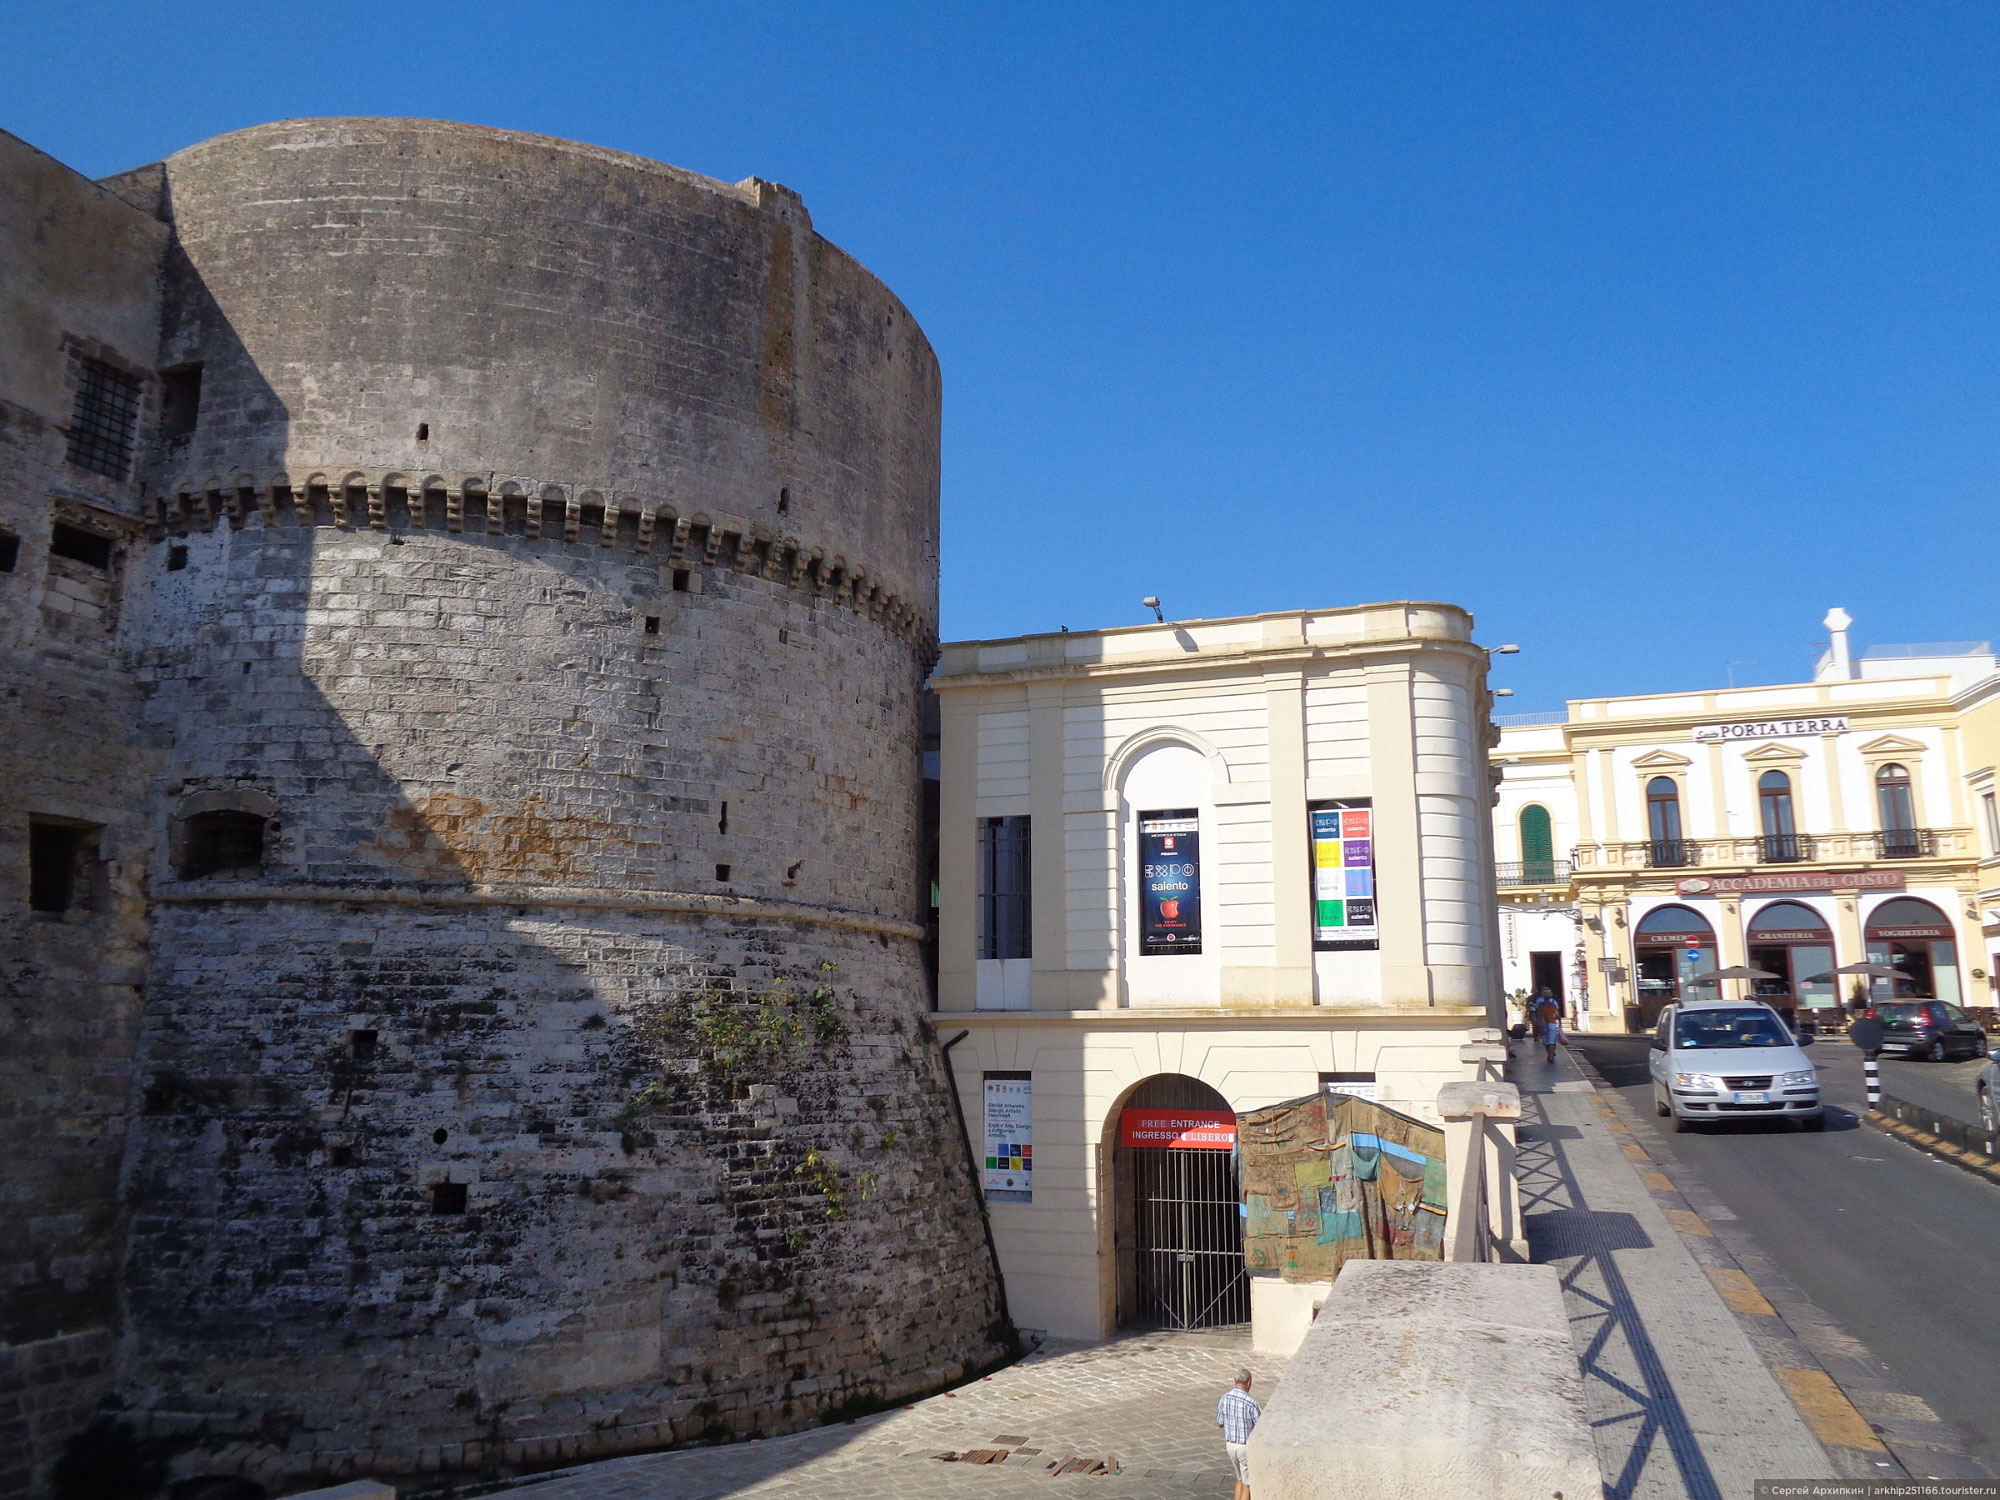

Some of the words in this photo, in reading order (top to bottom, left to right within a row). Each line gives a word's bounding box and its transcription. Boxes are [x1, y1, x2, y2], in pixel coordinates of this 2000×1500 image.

[1720, 724, 1779, 738] PORTA
[1781, 719, 1847, 733] TERRA
[1144, 863, 1195, 878] EXPO
[1151, 881, 1189, 891] salento
[1710, 877, 1811, 891] ACCADEMIA
[1814, 878, 1837, 888] DEL
[1842, 873, 1898, 887] GUSTO
[1757, 932, 1815, 940] GRANITERIA
[1877, 929, 1940, 937] YOGURTERIA
[1141, 1119, 1167, 1128] FREE
[1170, 1119, 1220, 1129] ENTRANCE
[1132, 1131, 1179, 1139] INGRESSO
[1191, 1133, 1228, 1141] LIBERO
